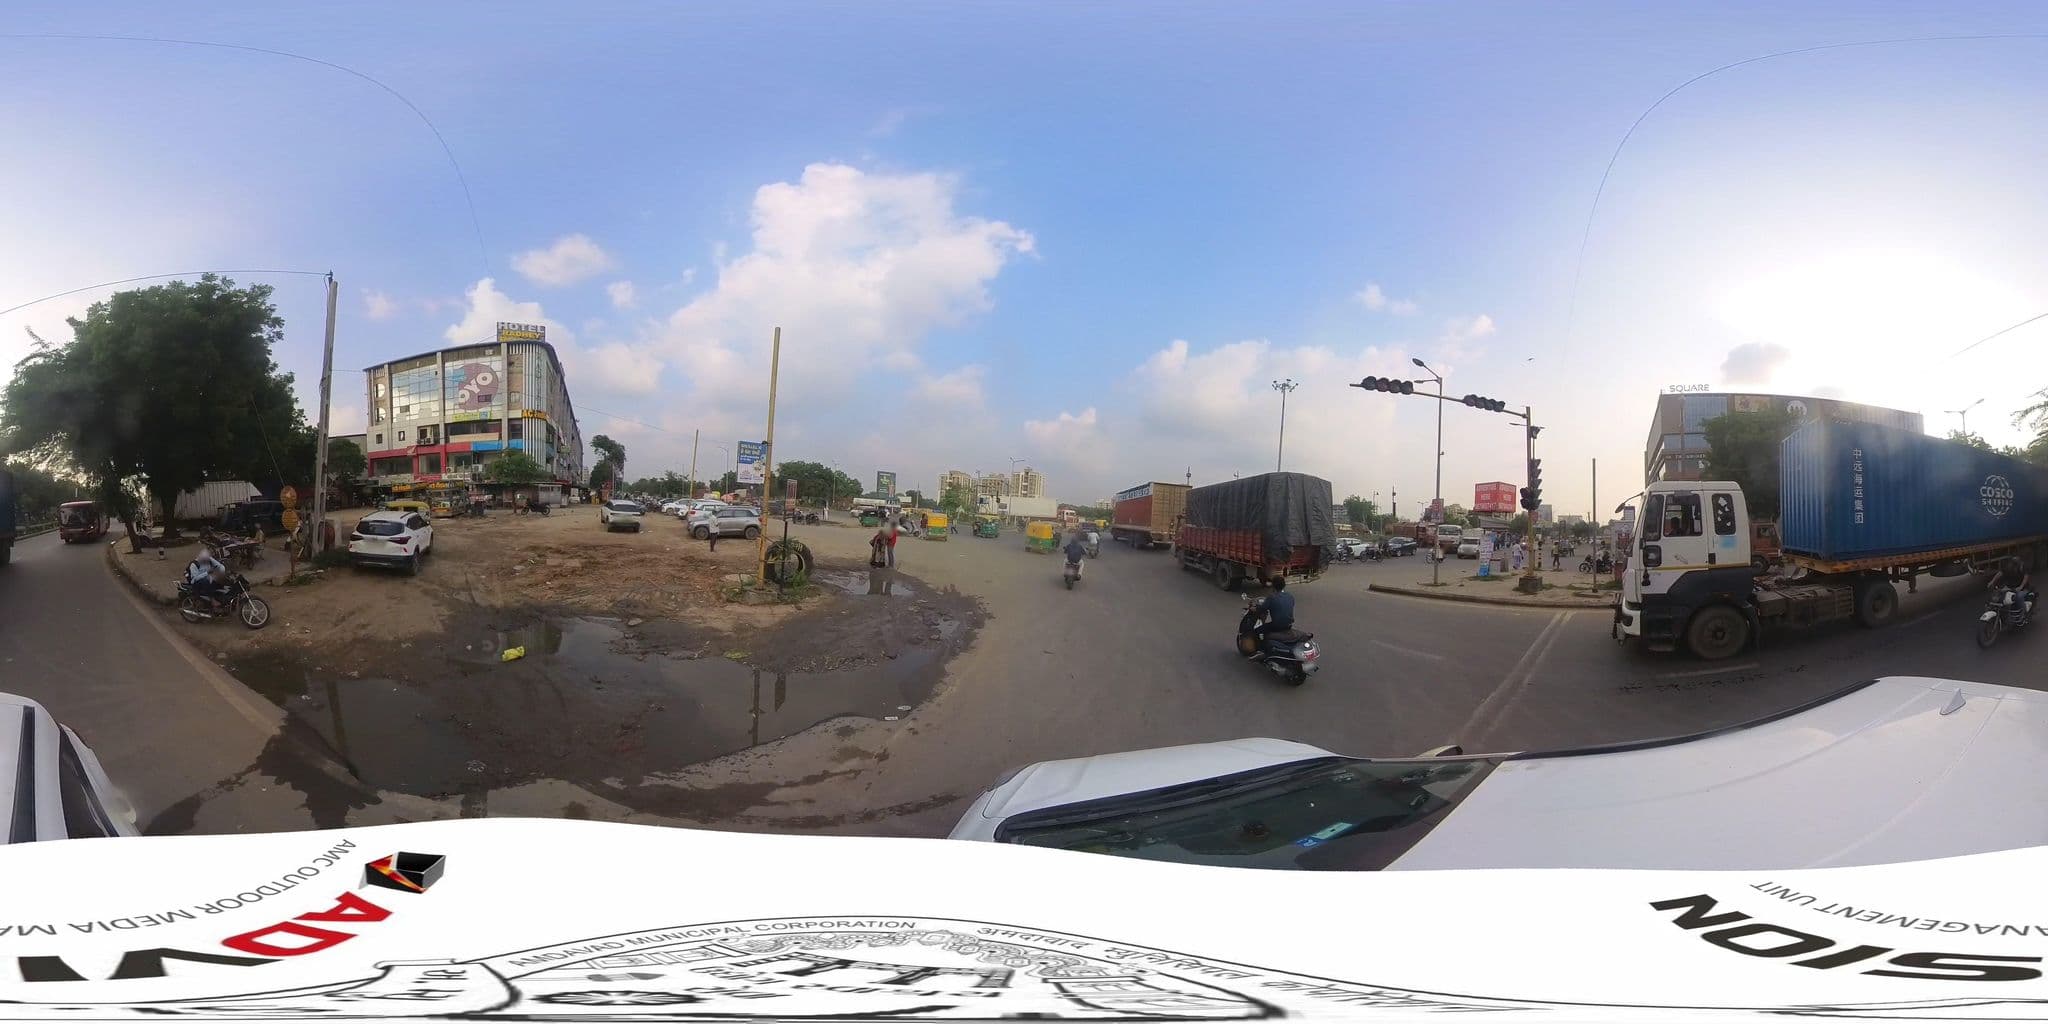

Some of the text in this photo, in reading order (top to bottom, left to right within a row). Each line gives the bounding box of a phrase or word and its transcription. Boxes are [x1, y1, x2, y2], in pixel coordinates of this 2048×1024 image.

[498, 322, 545, 333] HOTEL
[458, 372, 493, 403] OYO
[1669, 384, 1710, 393] SQUARE
[1979, 486, 2014, 499] COSCO
